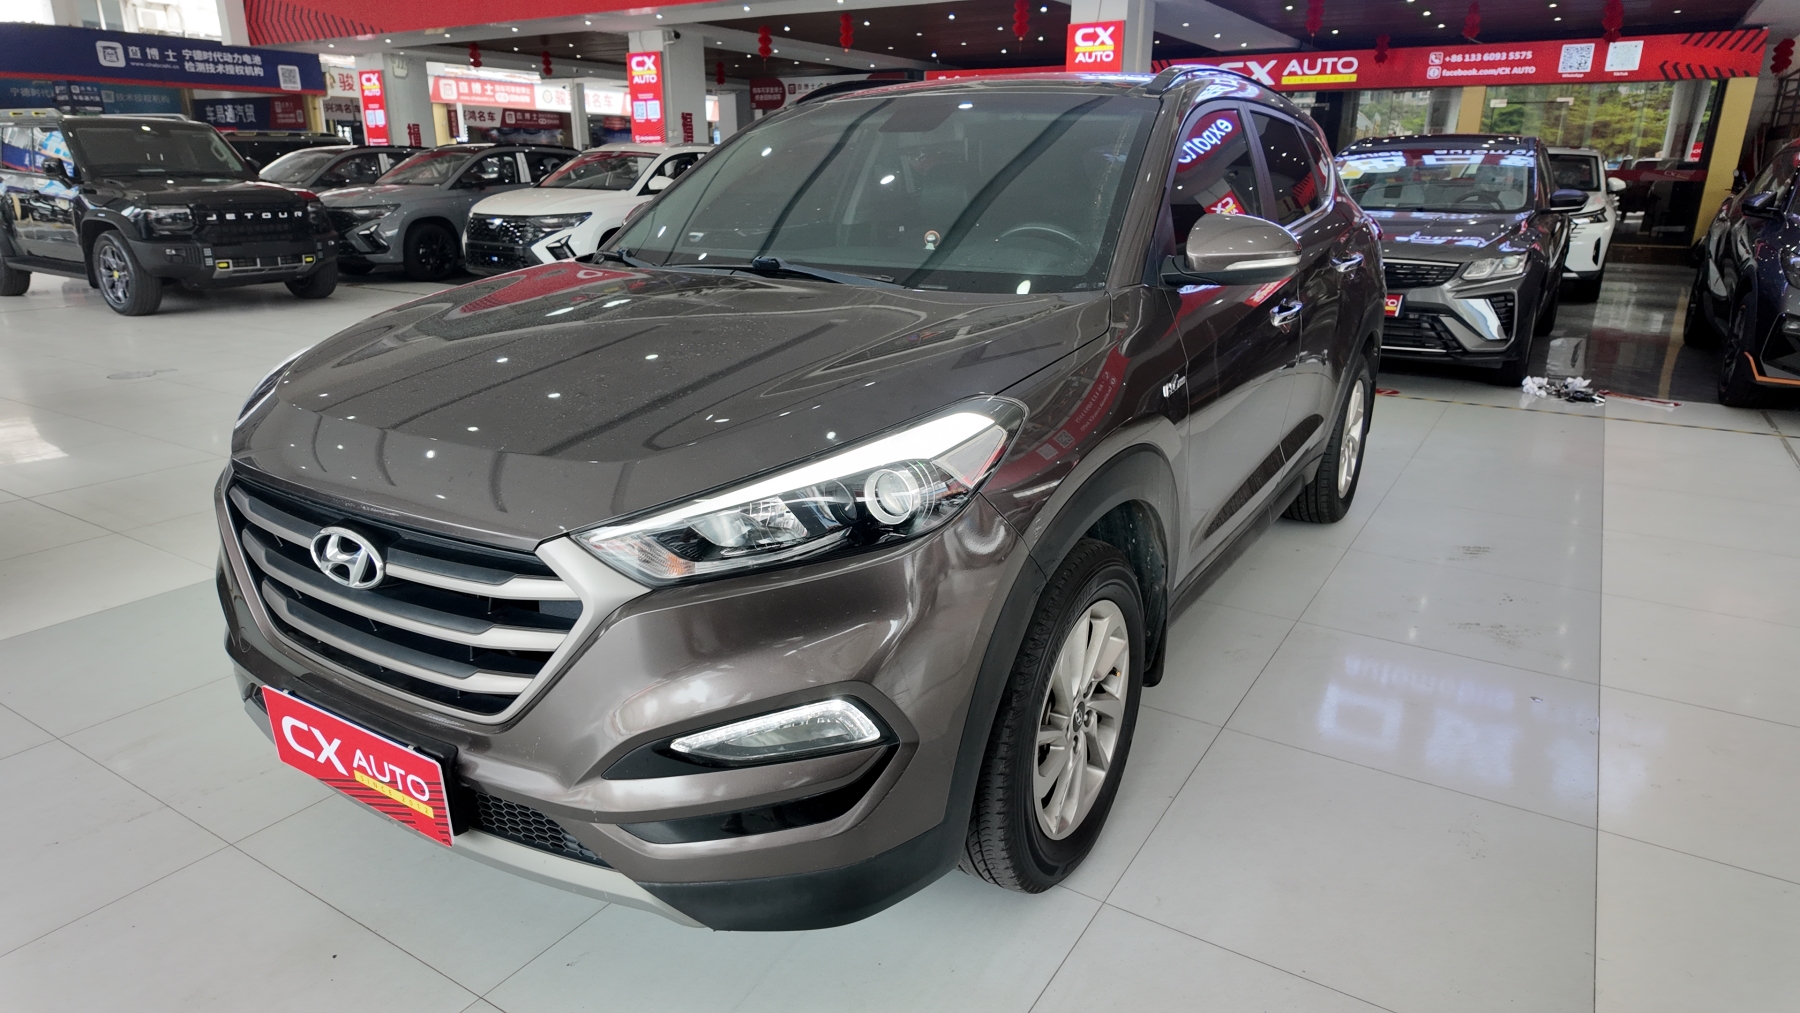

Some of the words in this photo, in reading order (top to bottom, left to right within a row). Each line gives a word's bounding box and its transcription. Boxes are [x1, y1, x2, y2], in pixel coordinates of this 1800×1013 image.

[1075, 26, 1115, 46] CX
[127, 46, 178, 62] 查博士
[182, 49, 262, 65] 宁德时代动力电池
[1075, 51, 1114, 63] AUTO
[1445, 53, 1463, 62] +86
[1465, 53, 1482, 62] 133
[1483, 52, 1507, 62] 6093
[1508, 51, 1533, 60] 5575
[184, 61, 264, 77] 检测技术授权机构
[631, 55, 657, 71] CX
[1282, 57, 1359, 75] AUTO
[1442, 67, 1511, 76] facebook.com/CX
[1512, 66, 1536, 75] AUTO
[338, 73, 356, 92] 骏
[361, 73, 380, 86] CX
[633, 74, 658, 84] AUTO
[363, 88, 382, 97] AUTO
[458, 81, 494, 95] 查博士
[205, 104, 256, 123] 车易通汽贸
[206, 210, 303, 221] JETOUR
[281, 715, 349, 777] CX
[352, 748, 430, 802] AUTO
[359, 774, 394, 798] SINCE
[401, 795, 430, 815] 2012
